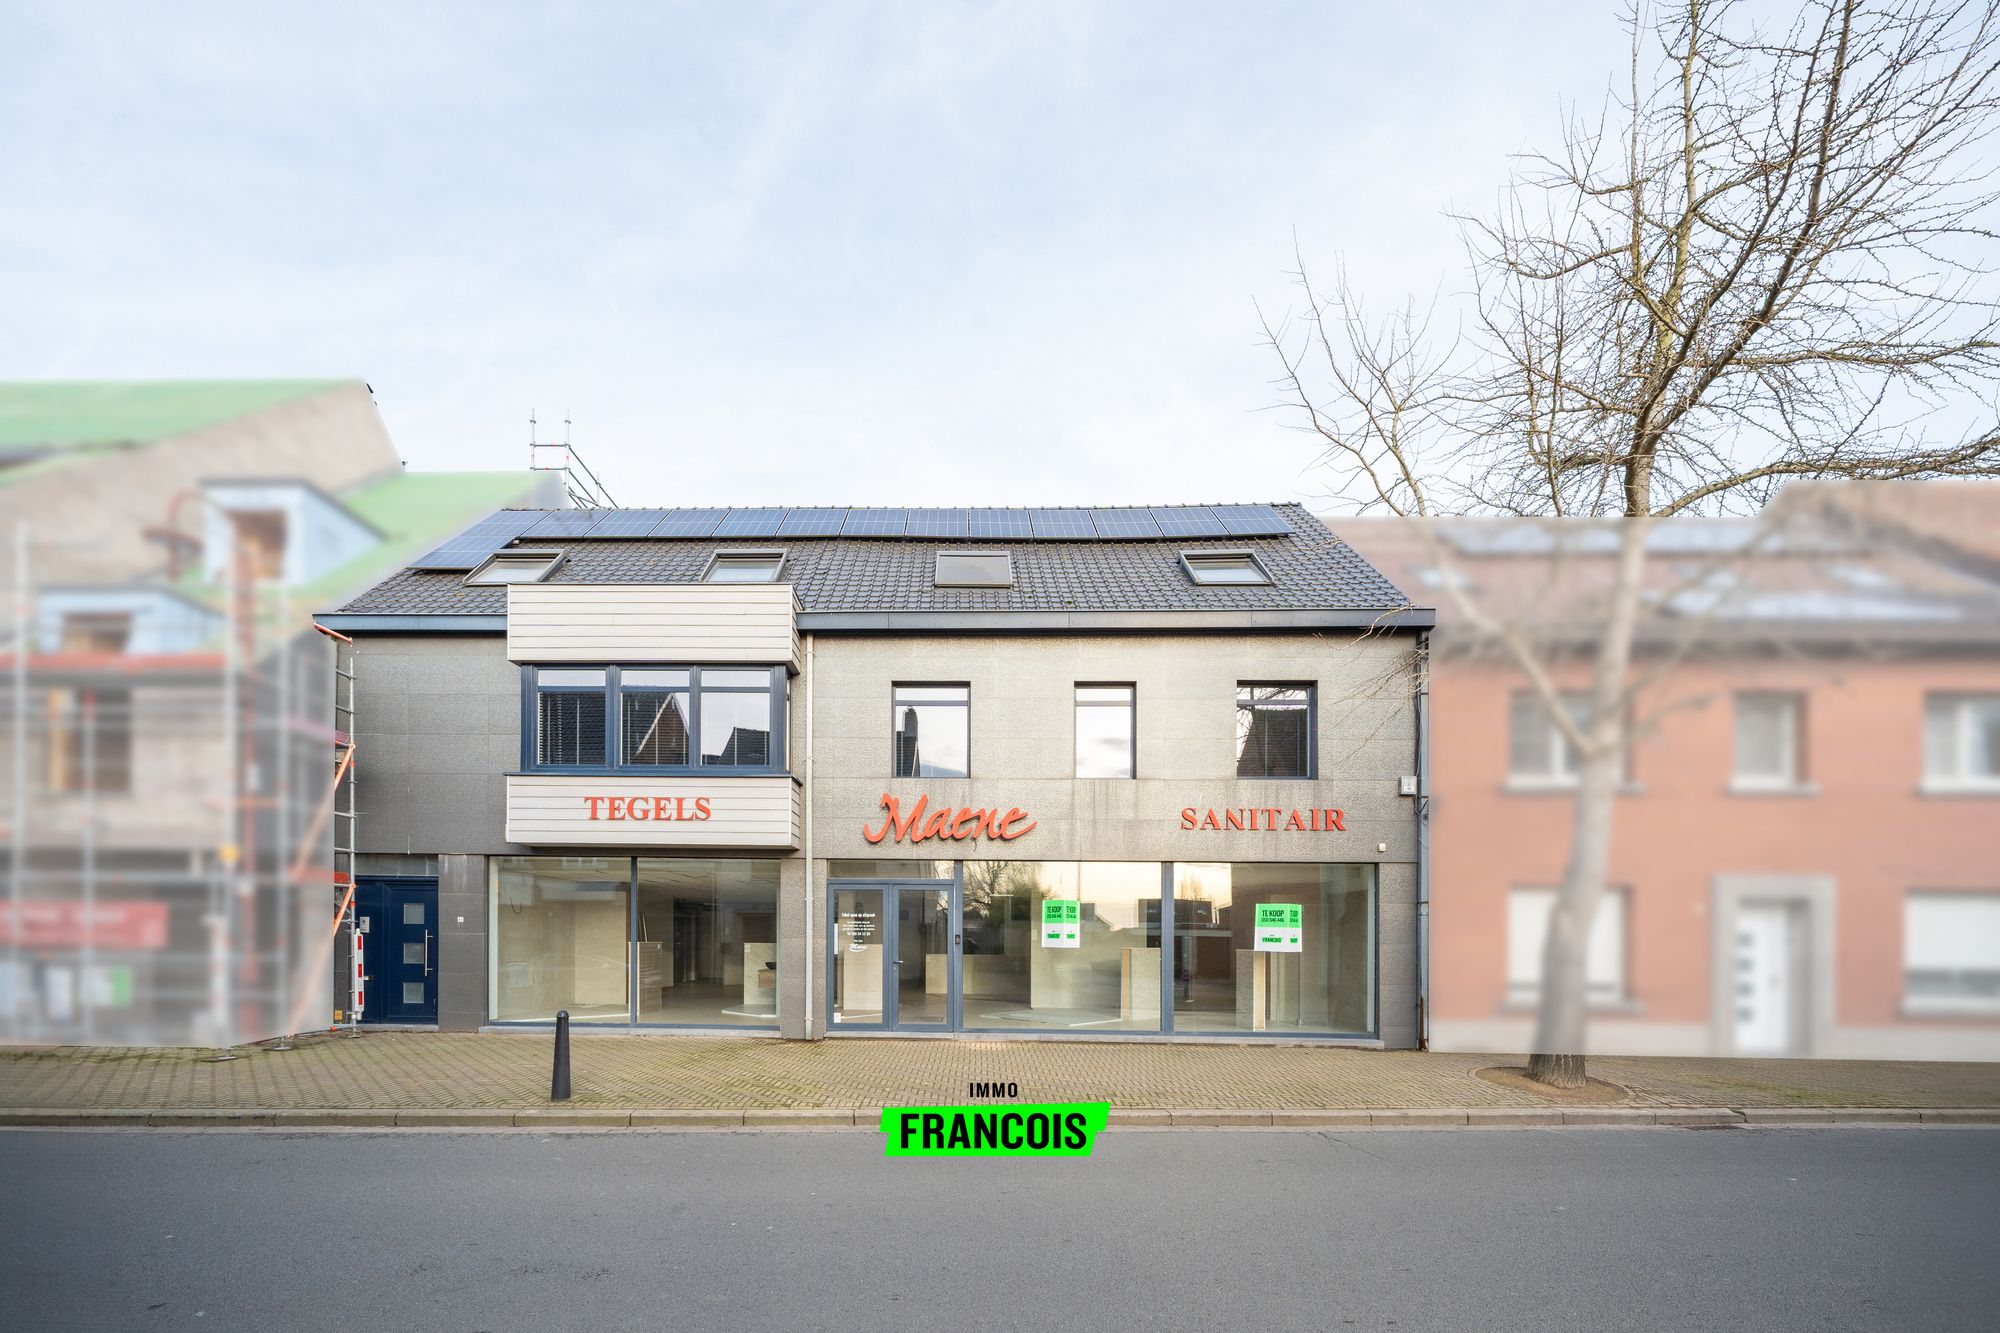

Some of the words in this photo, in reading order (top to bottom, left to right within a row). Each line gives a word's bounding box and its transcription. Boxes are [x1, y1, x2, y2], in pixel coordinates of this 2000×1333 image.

[583, 796, 711, 821] TEGELS
[863, 792, 1038, 844] Maene
[1181, 806, 1347, 831] SANITAIR
[1262, 909, 1269, 917] TE
[1269, 909, 1285, 917] KOOP
